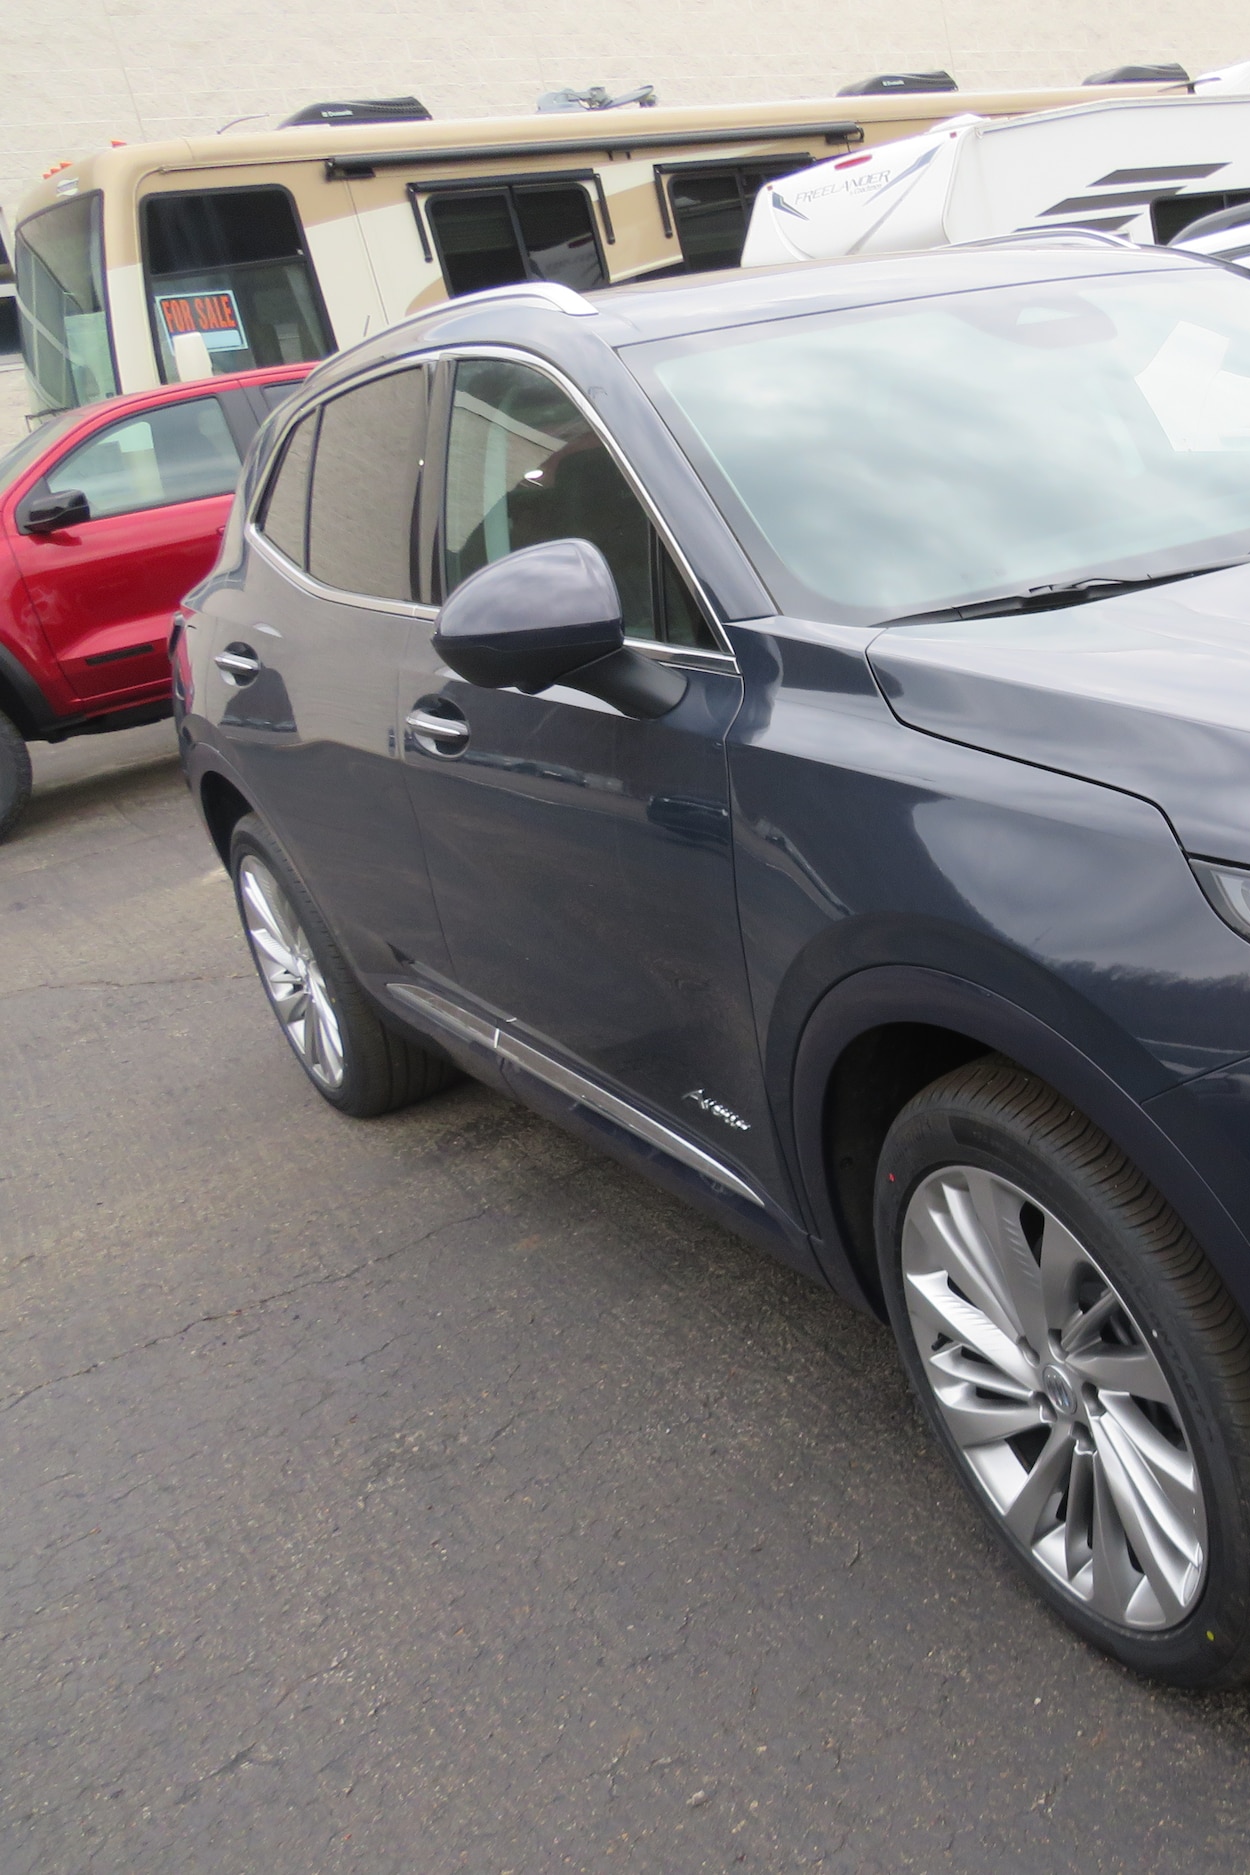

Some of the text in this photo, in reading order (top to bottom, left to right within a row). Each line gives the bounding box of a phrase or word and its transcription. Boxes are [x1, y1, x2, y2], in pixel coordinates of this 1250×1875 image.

[794, 169, 891, 205] FREELANDER
[161, 295, 237, 333] FOR SALE
